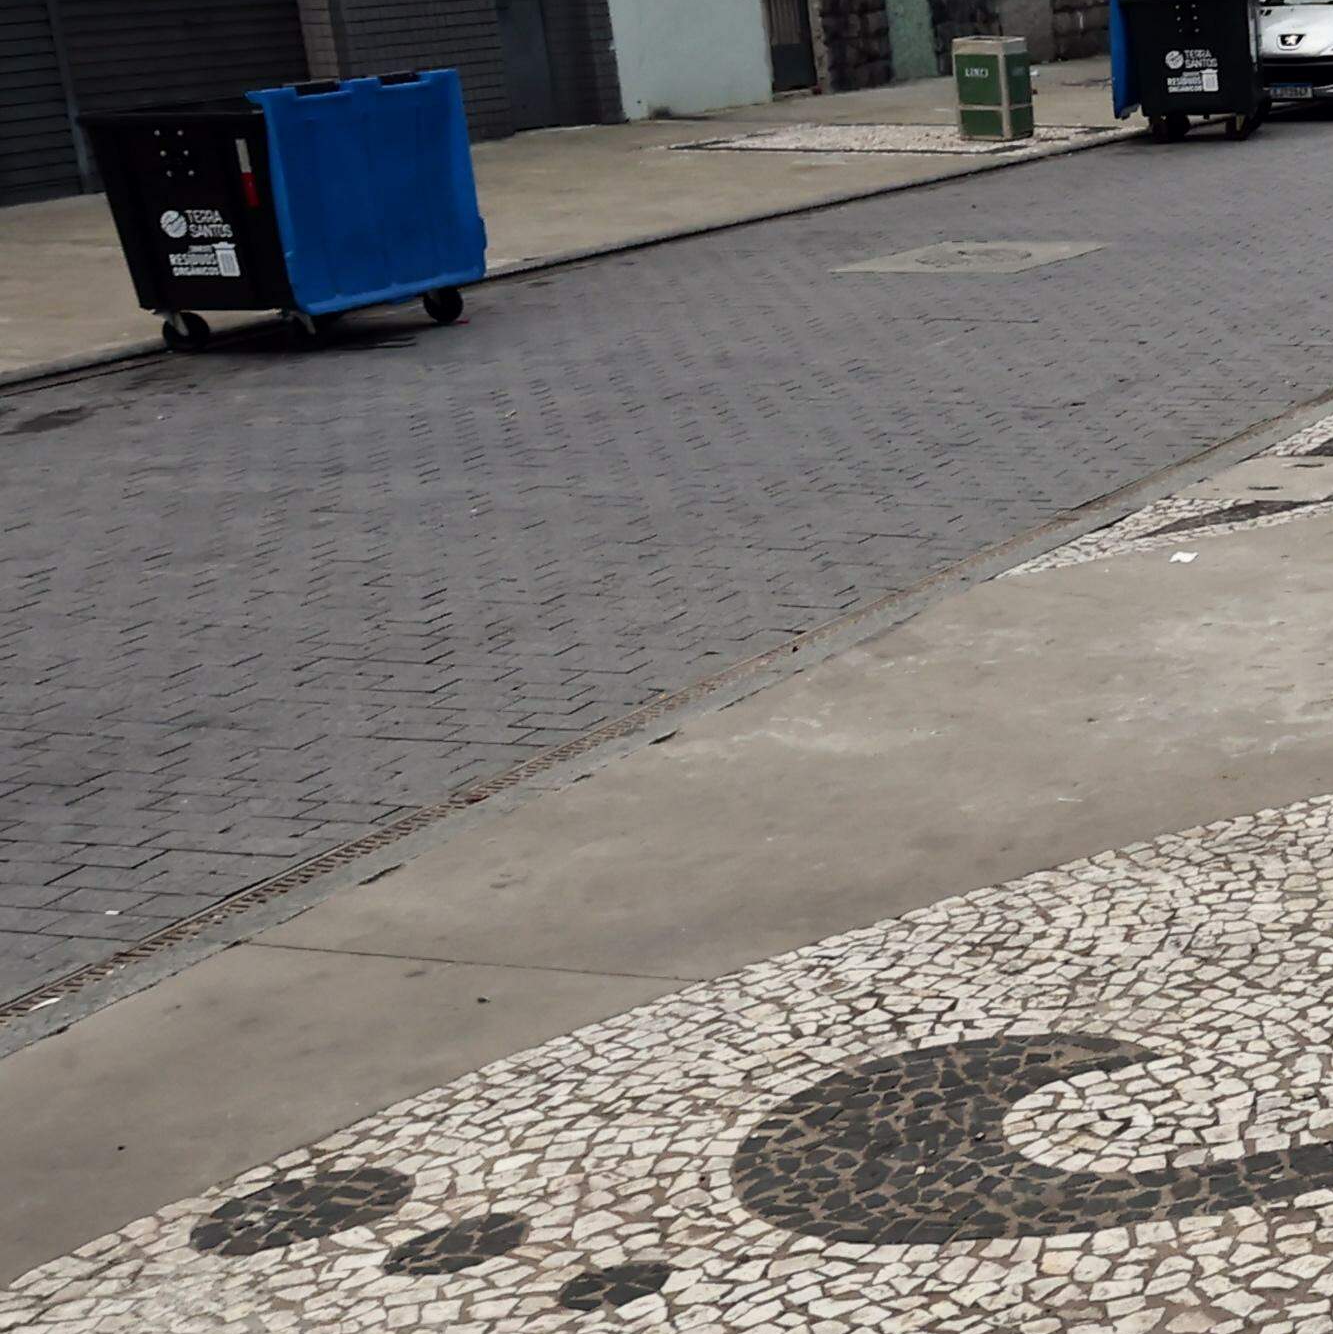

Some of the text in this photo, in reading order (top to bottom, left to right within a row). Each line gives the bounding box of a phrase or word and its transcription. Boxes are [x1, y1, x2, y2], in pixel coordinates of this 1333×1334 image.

[1183, 49, 1212, 59] TERRA
[1184, 58, 1218, 68] SANTOS
[184, 209, 223, 223] TERRA
[188, 223, 234, 237] SANTOS
